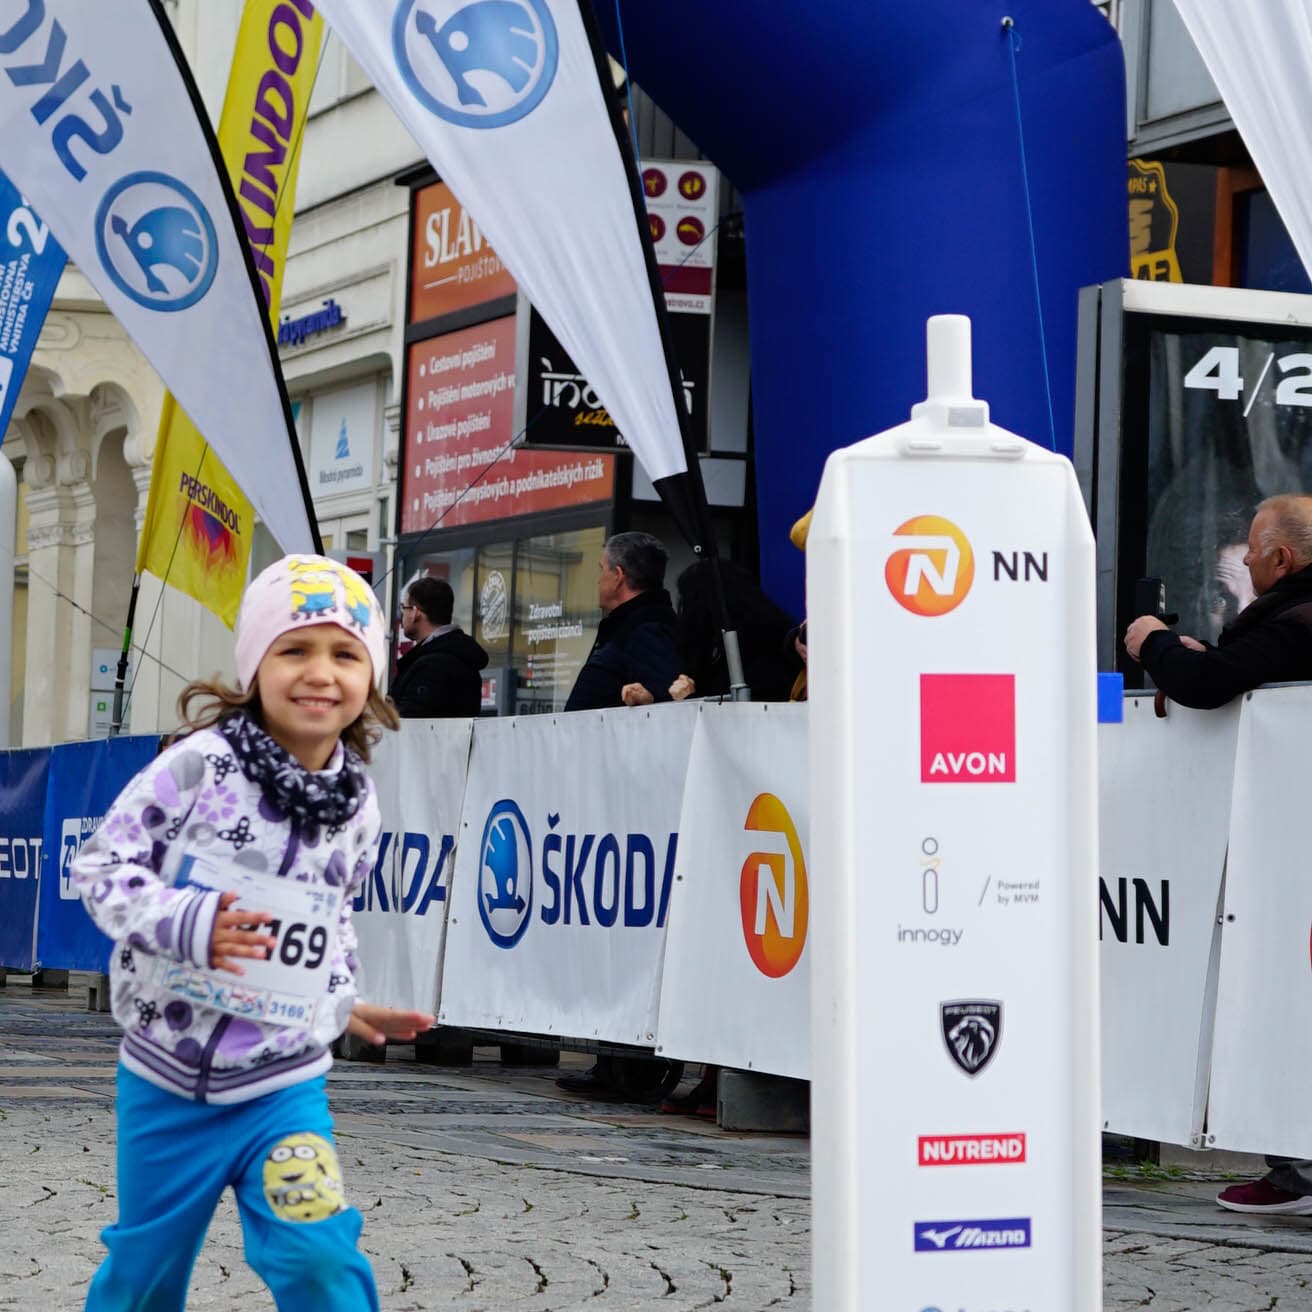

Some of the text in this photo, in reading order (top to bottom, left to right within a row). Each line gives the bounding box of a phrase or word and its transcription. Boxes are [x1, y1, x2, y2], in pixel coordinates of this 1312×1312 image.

[7, 303, 30, 354] VNITRA
[178, 471, 242, 536] PERSKINDOL
[991, 550, 1049, 582] NN
[929, 752, 1007, 775] AVON
[997, 880, 1040, 891] Powered
[997, 893, 1040, 906] by MVM
[236, 918, 328, 970] 169
[897, 925, 964, 946] innogy
[922, 1136, 1023, 1163] NUTREND
